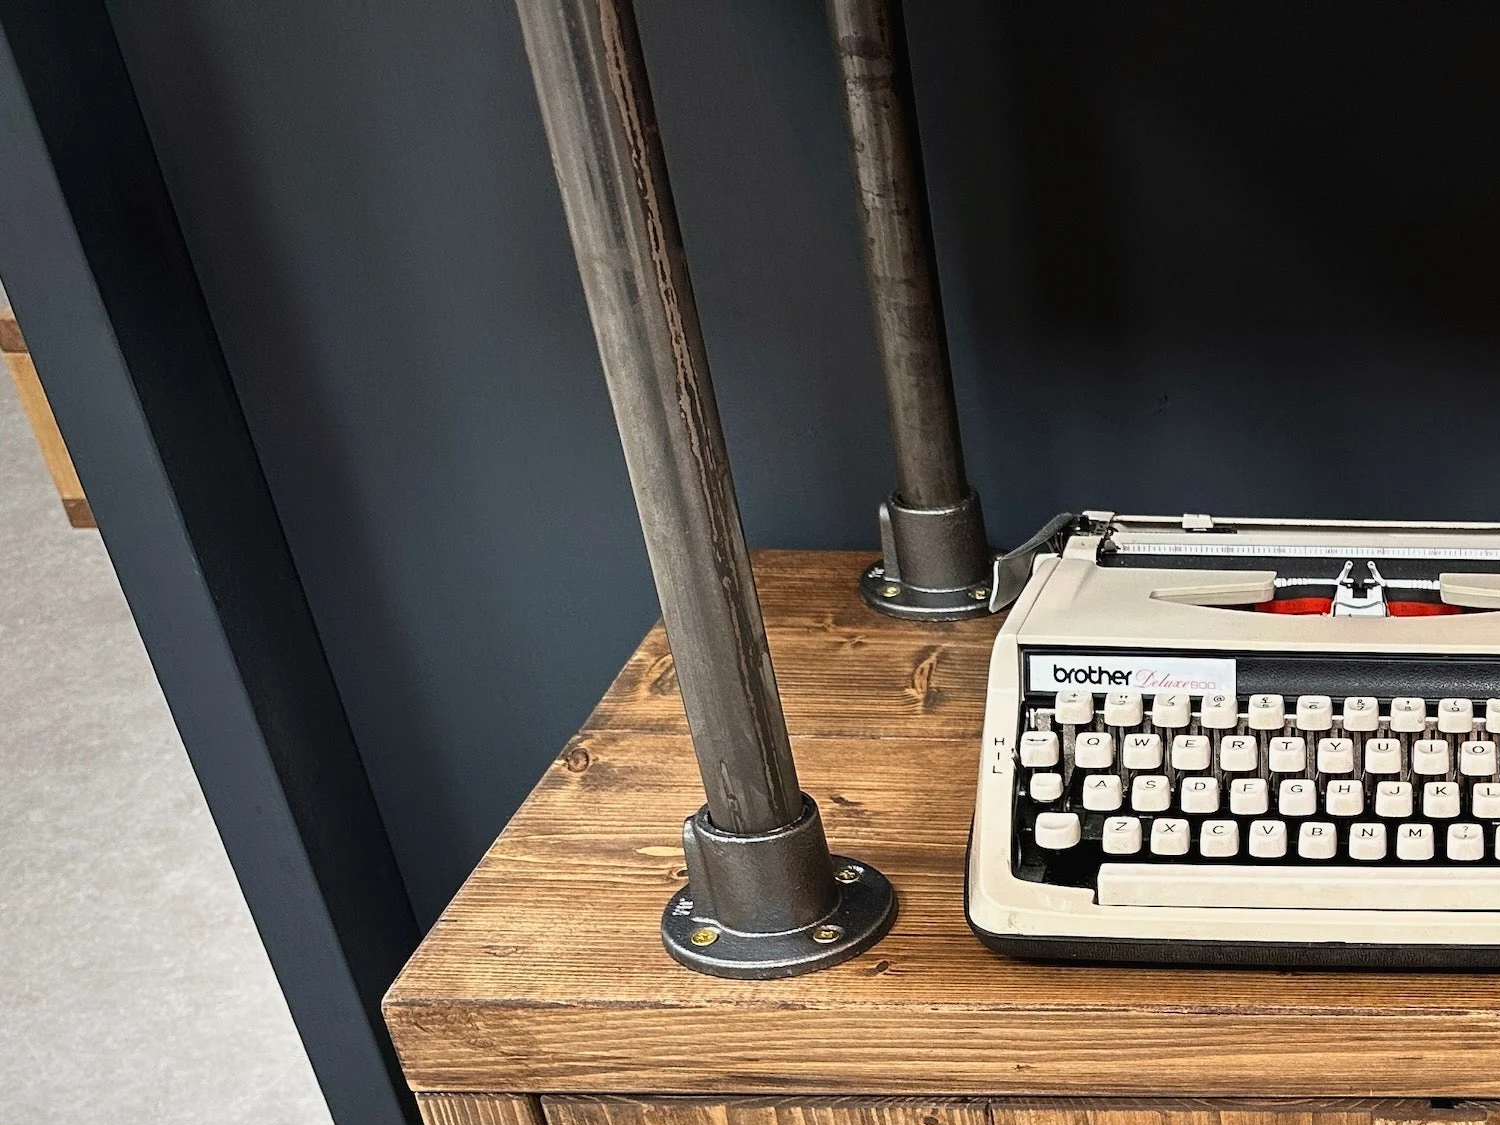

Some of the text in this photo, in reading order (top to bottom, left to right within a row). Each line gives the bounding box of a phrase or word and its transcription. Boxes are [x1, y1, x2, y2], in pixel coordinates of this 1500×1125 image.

[1053, 664, 1132, 685] brother
[1144, 780, 1156, 789] S
[1244, 784, 1254, 792] F
[1486, 787, 1496, 796] L
[1115, 822, 1127, 830] Z
[1164, 824, 1175, 832] X
[1213, 826, 1223, 834] C
[1263, 826, 1273, 834] V
[1409, 829, 1421, 837] M
